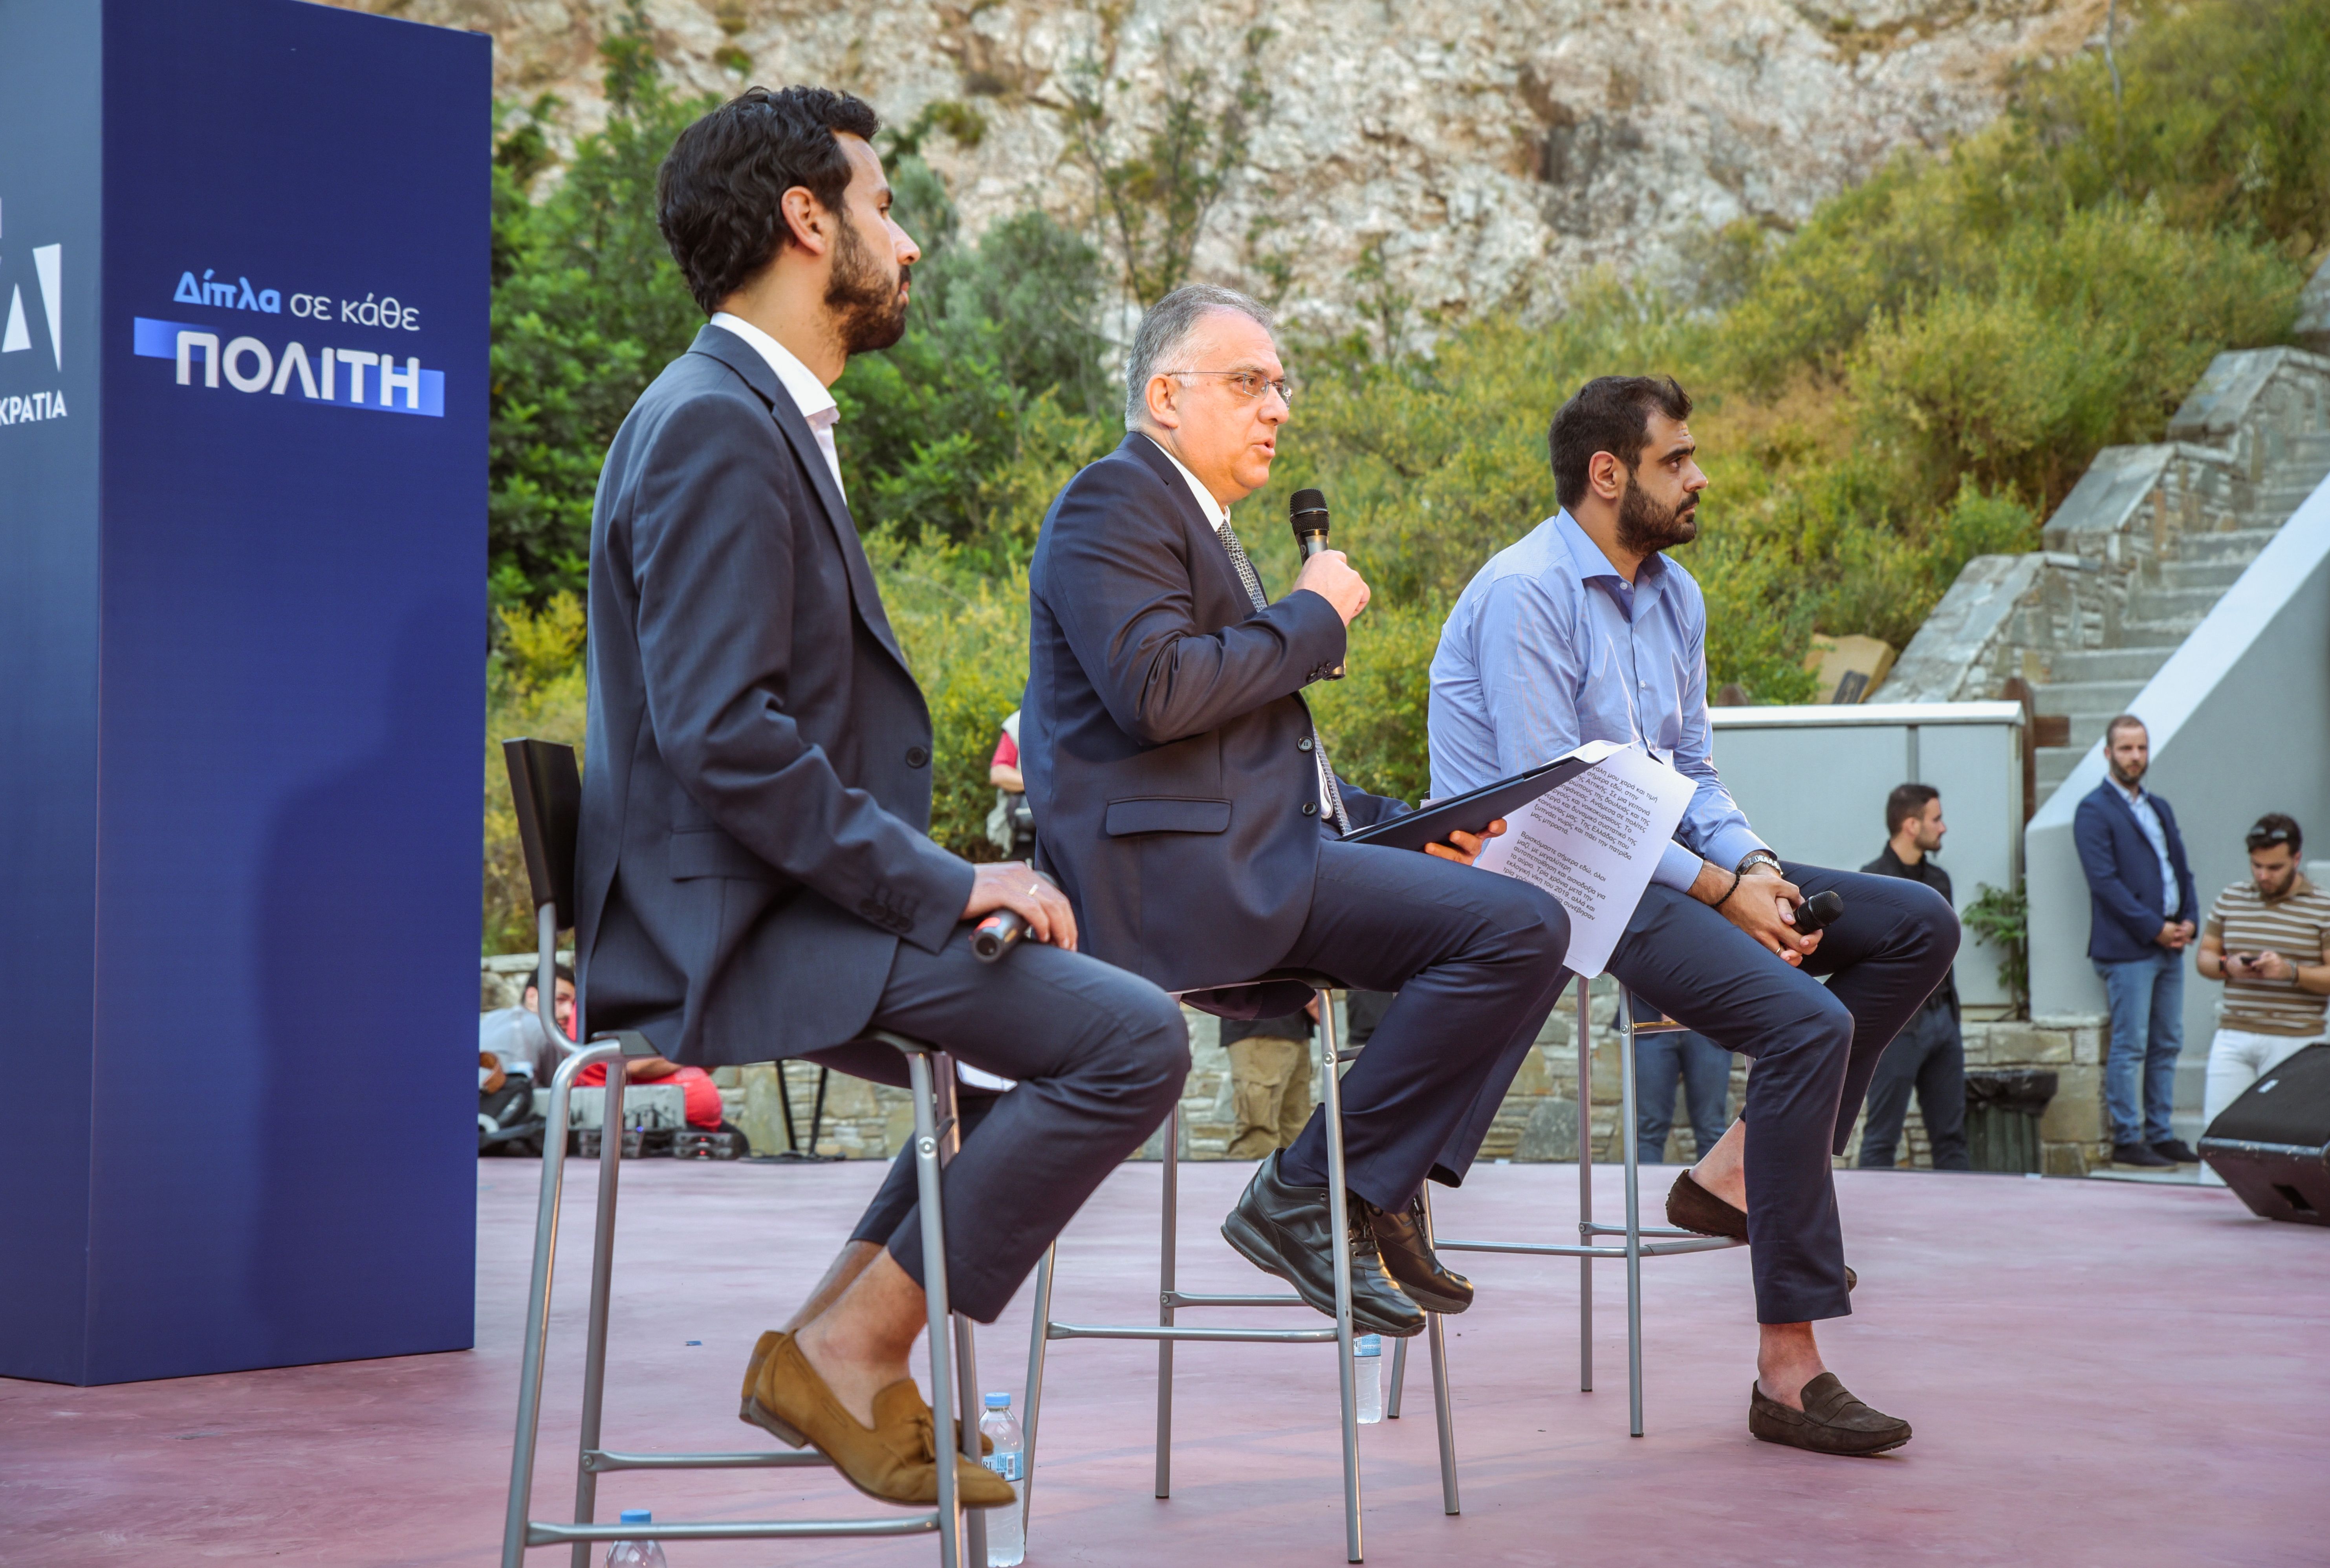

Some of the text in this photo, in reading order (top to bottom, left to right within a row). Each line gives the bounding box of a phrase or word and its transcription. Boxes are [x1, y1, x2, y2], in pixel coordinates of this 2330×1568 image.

[173, 268, 420, 331] Δίπλα σε κάθε
[176, 330, 420, 409] ΠΟΛΙΤΗ
[1586, 771, 1610, 785] σήμερα
[1624, 790, 1639, 800] στην
[1606, 773, 1619, 781] μου
[1619, 779, 1636, 790] χαρά
[1646, 792, 1658, 803] τιμή
[1609, 789, 1617, 798] Σε
[1616, 795, 1627, 804] μια
[1628, 800, 1650, 816] γειτονιά
[1530, 811, 1542, 821] μας
[1537, 796, 1566, 816] κοινωνίας
[1580, 818, 1591, 830] Της
[1591, 825, 1617, 844] Ελλάδας
[1617, 840, 1629, 850] που
[1571, 805, 1597, 823] δυναμικό
[1597, 821, 1626, 839] συστατικό
[1627, 836, 1638, 846] της
[1589, 798, 1616, 815] Ανάμεσα
[1625, 817, 1647, 833] πολίτες
[1594, 791, 1604, 801] της
[1604, 796, 1630, 815] δουλειάς
[1630, 811, 1639, 819] και
[1640, 816, 1650, 826] της
[1534, 803, 1557, 819] ξυπνάει
[1557, 816, 1574, 830] νωρίς
[1584, 831, 1597, 841] πάει
[1597, 838, 1608, 847] την
[1608, 844, 1632, 860] πατρίδα
[1624, 824, 1632, 833] Το
[1513, 846, 1557, 874] αυτοπεποίθηση
[1566, 876, 1596, 894] αισιοδοξία
[1596, 892, 1606, 900] για
[1520, 830, 1557, 855] Βρισκόμαστε
[1557, 852, 1579, 867] σήμερα
[1593, 871, 1606, 882] όλοι
[1538, 851, 1571, 873] μεγαλύτερη
[1503, 866, 1515, 876] τρία
[1564, 901, 1595, 920] συνέβησαν
[1506, 860, 1531, 877] εκλογική
[1531, 873, 1543, 884] νίκη
[1543, 880, 1554, 888] του
[1571, 896, 1586, 907] αλλά
[1585, 904, 1595, 912] και
[1536, 866, 1549, 877] Τρία
[1548, 874, 1569, 888] χρόνια
[1568, 885, 1583, 896] μετά
[1583, 893, 1593, 901] την
